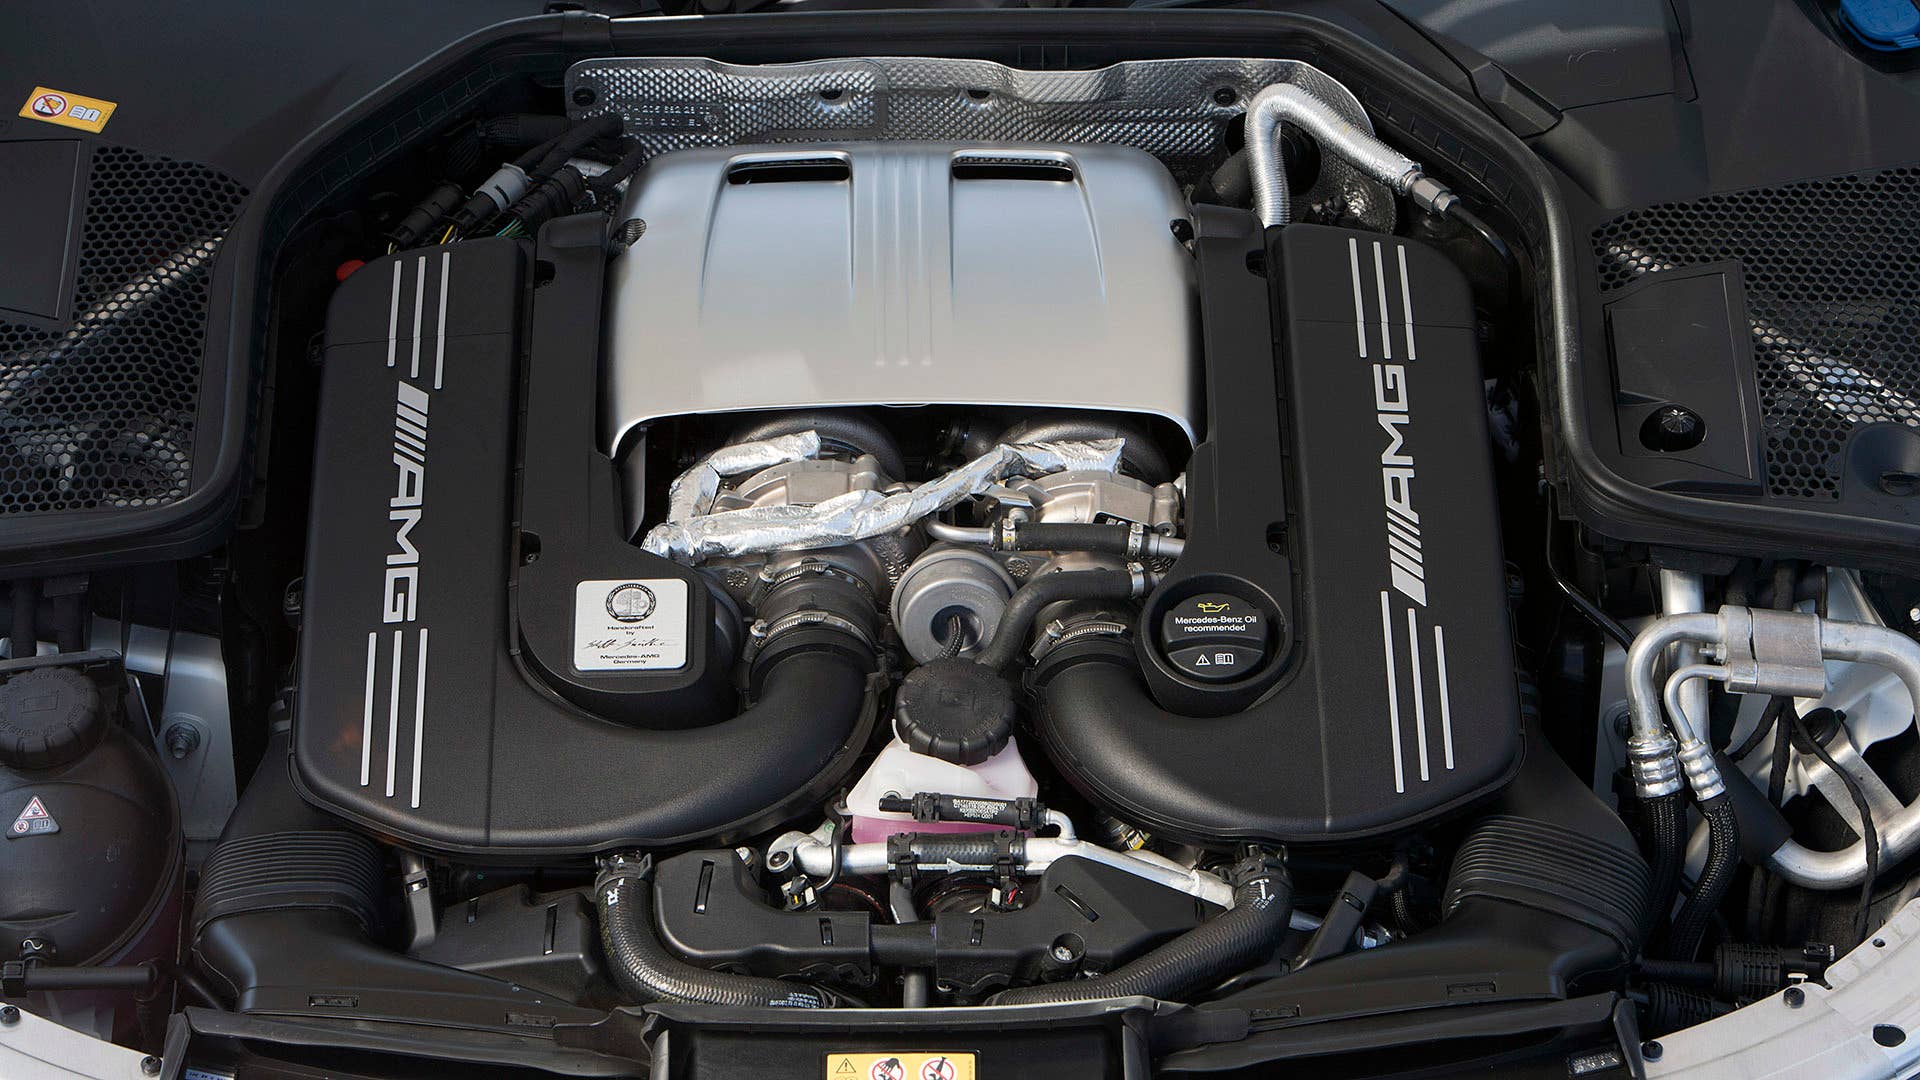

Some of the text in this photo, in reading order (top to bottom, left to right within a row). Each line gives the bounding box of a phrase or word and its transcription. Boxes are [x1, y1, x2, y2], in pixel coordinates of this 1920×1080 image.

[1373, 364, 1419, 524] AMG
[383, 452, 425, 623] AMG
[1175, 615, 1257, 625] Mercedes-Benz Oil
[1184, 624, 1246, 632] recommended
